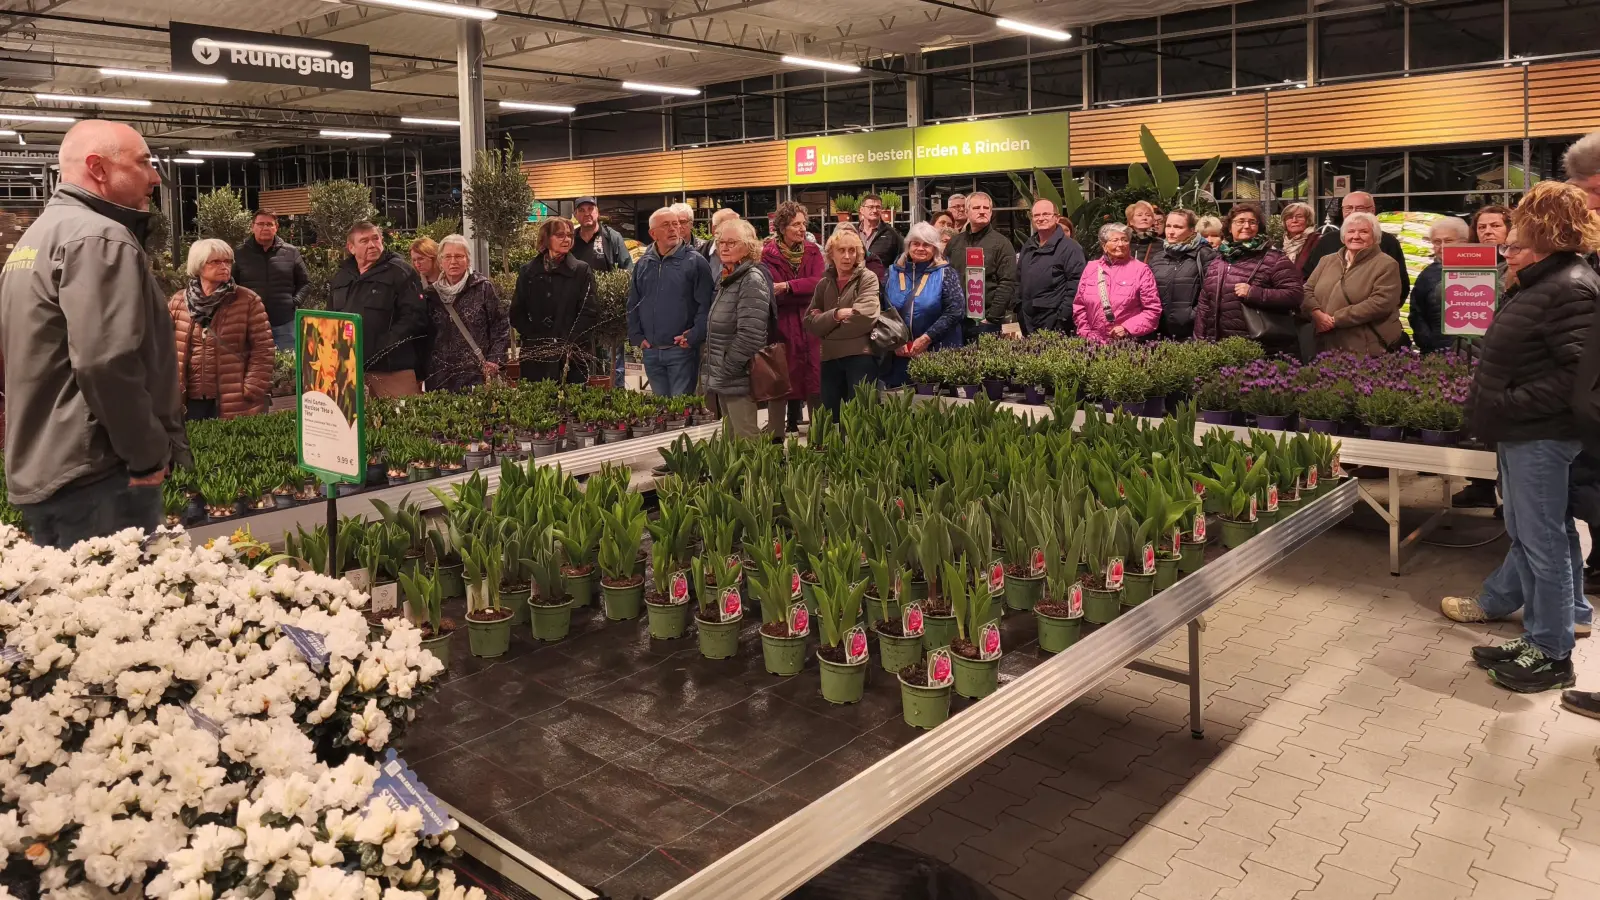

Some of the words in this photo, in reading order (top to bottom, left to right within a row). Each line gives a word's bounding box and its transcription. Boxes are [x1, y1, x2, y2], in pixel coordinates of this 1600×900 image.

[231, 47, 354, 79] Rundgang
[822, 152, 864, 166] Unsere
[867, 148, 913, 162] besten
[916, 145, 958, 159] Erden
[962, 143, 971, 155] &
[975, 138, 1030, 154] Rinden
[1453, 290, 1486, 298] Schopf-
[1452, 311, 1487, 320] 3,49€
[349, 458, 354, 466] €
